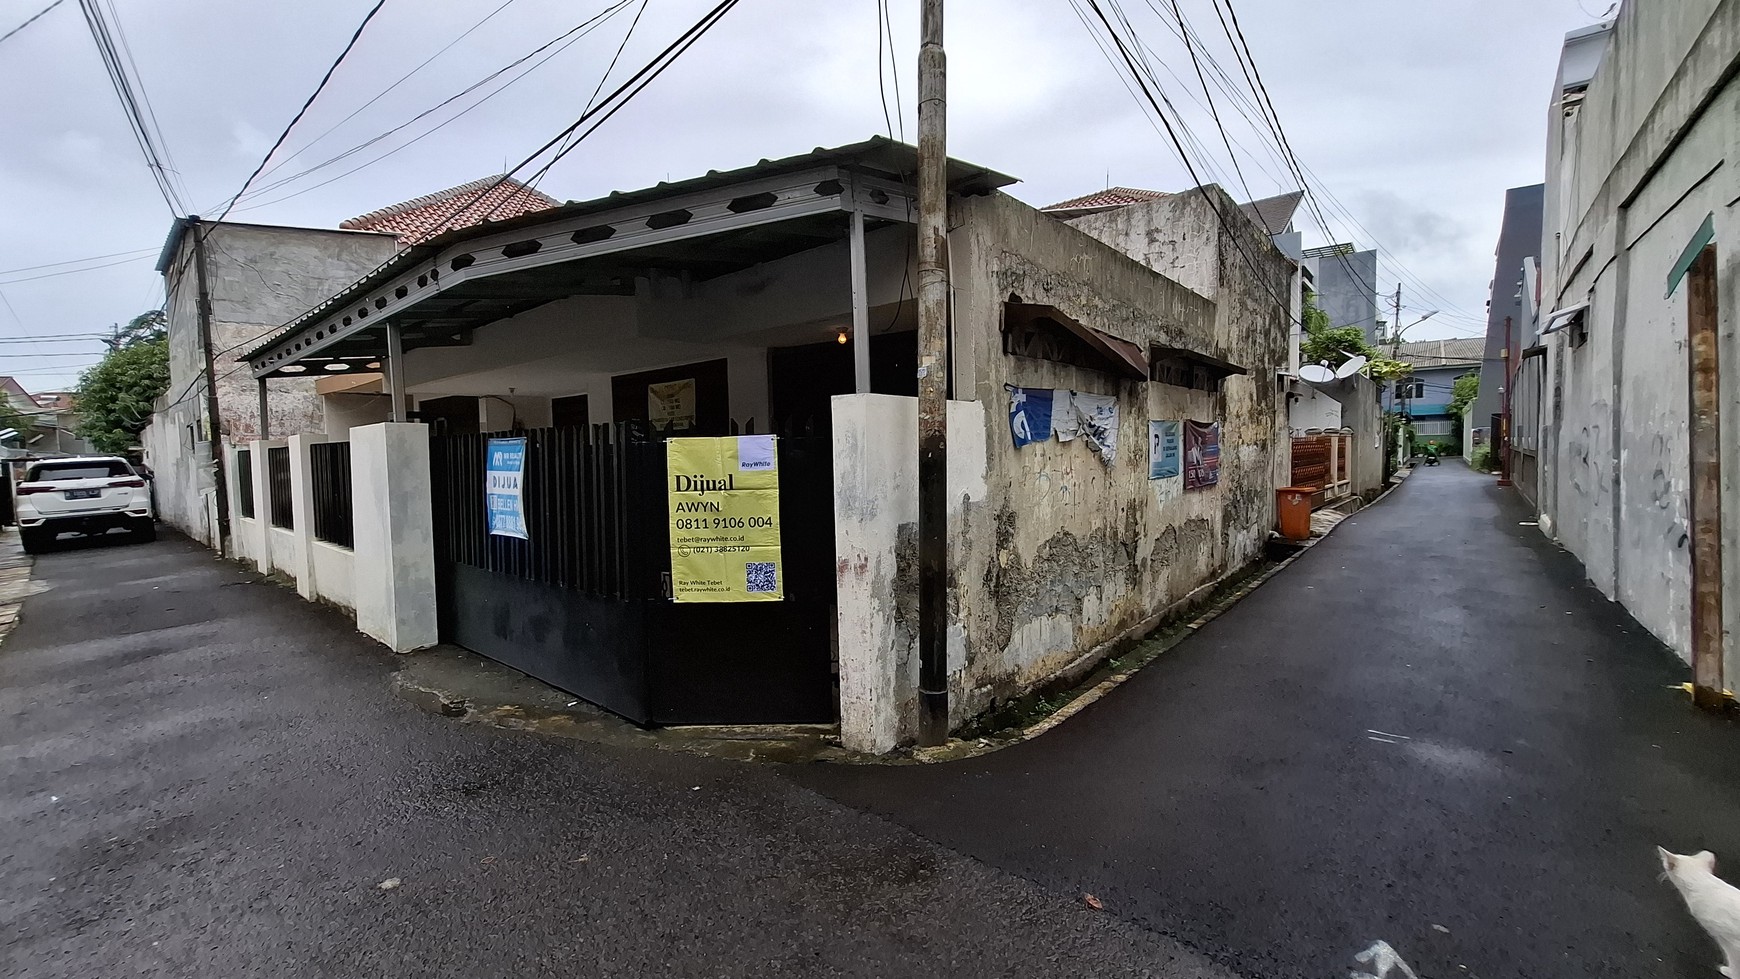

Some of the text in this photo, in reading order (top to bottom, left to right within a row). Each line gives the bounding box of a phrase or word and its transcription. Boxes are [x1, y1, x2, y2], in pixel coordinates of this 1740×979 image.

[675, 474, 734, 496] Dijual
[675, 501, 720, 513] AWYN
[676, 516, 773, 530] 0811 9106 004
[676, 535, 745, 543] tebet@raywhite.co.id
[693, 546, 713, 554] (021)
